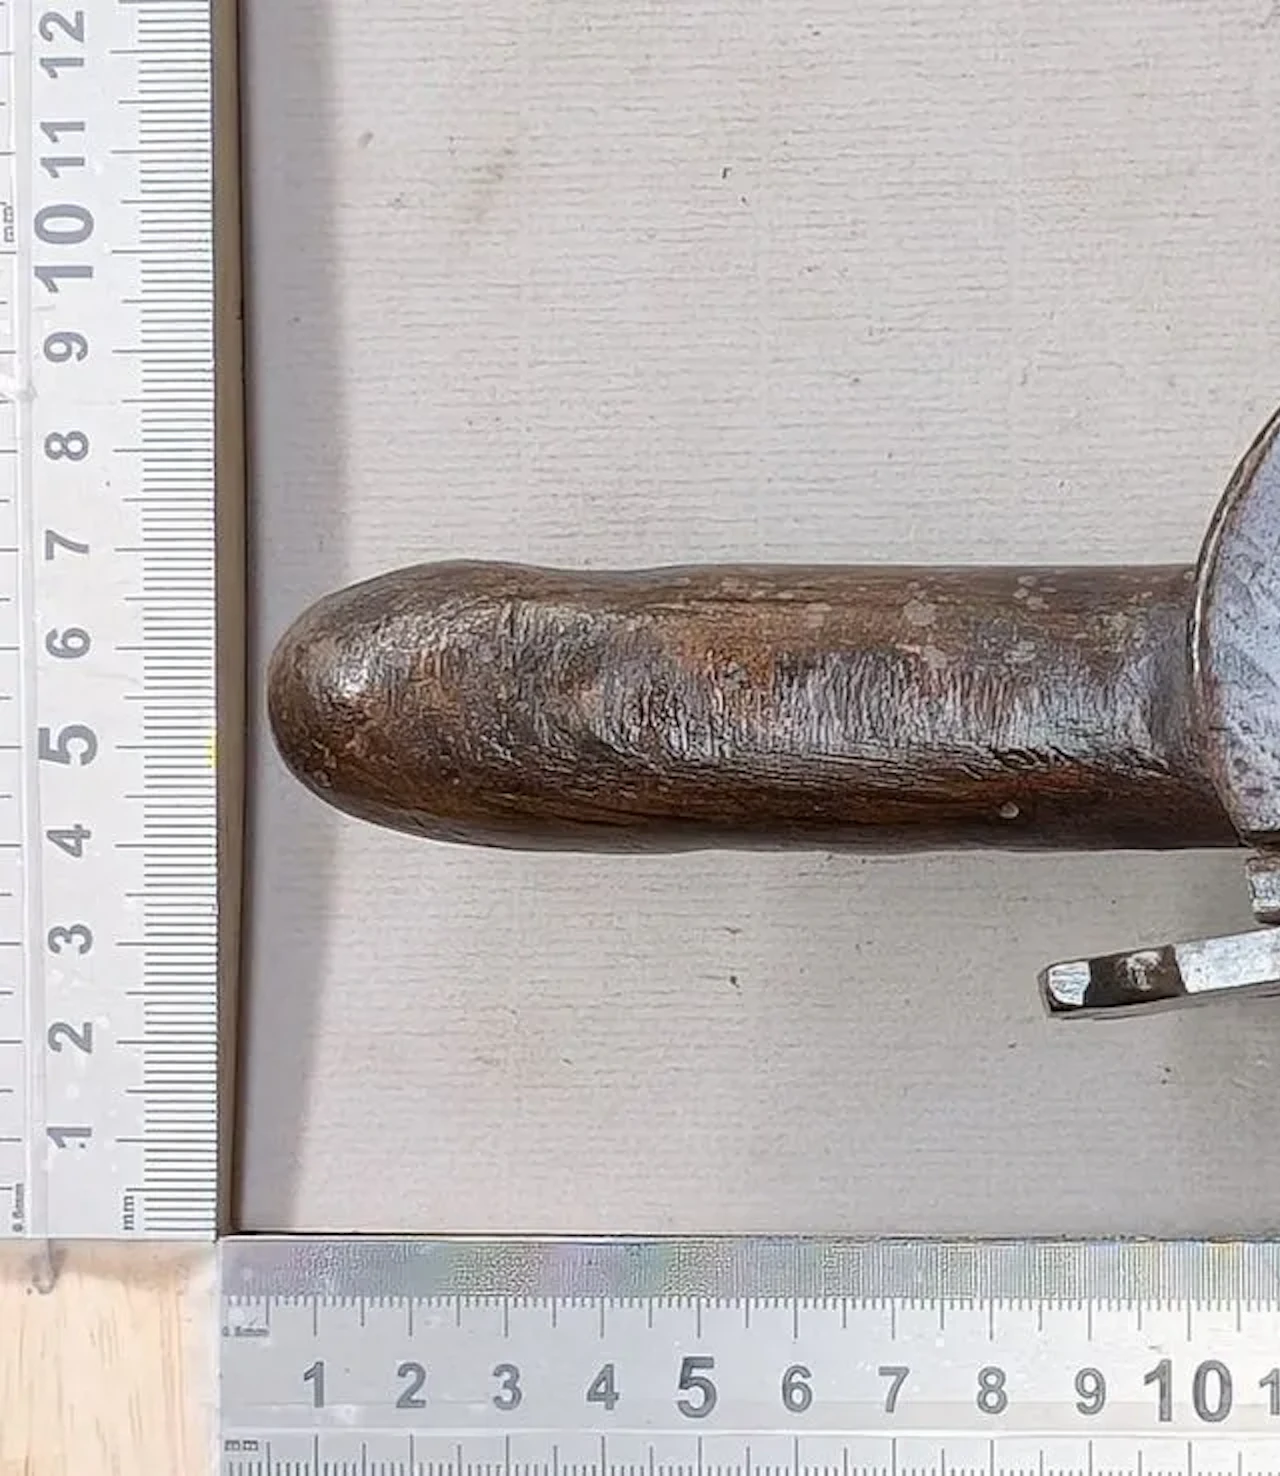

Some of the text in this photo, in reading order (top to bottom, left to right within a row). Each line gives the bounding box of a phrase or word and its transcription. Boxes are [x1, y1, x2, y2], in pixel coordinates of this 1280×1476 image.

[33, 10, 99, 1150] 1 2 3 4 5 6 7 8 9 10 11 12
[303, 1360, 325, 1409] 1
[395, 1361, 428, 1410] 2
[491, 1363, 523, 1412] 3
[585, 1363, 621, 1412] 4
[676, 1355, 718, 1419] 5
[781, 1363, 813, 1414] 6
[877, 1365, 911, 1415] 7
[975, 1365, 1009, 1416] 8
[1073, 1367, 1107, 1417] 9
[1143, 1358, 1233, 1424] 10
